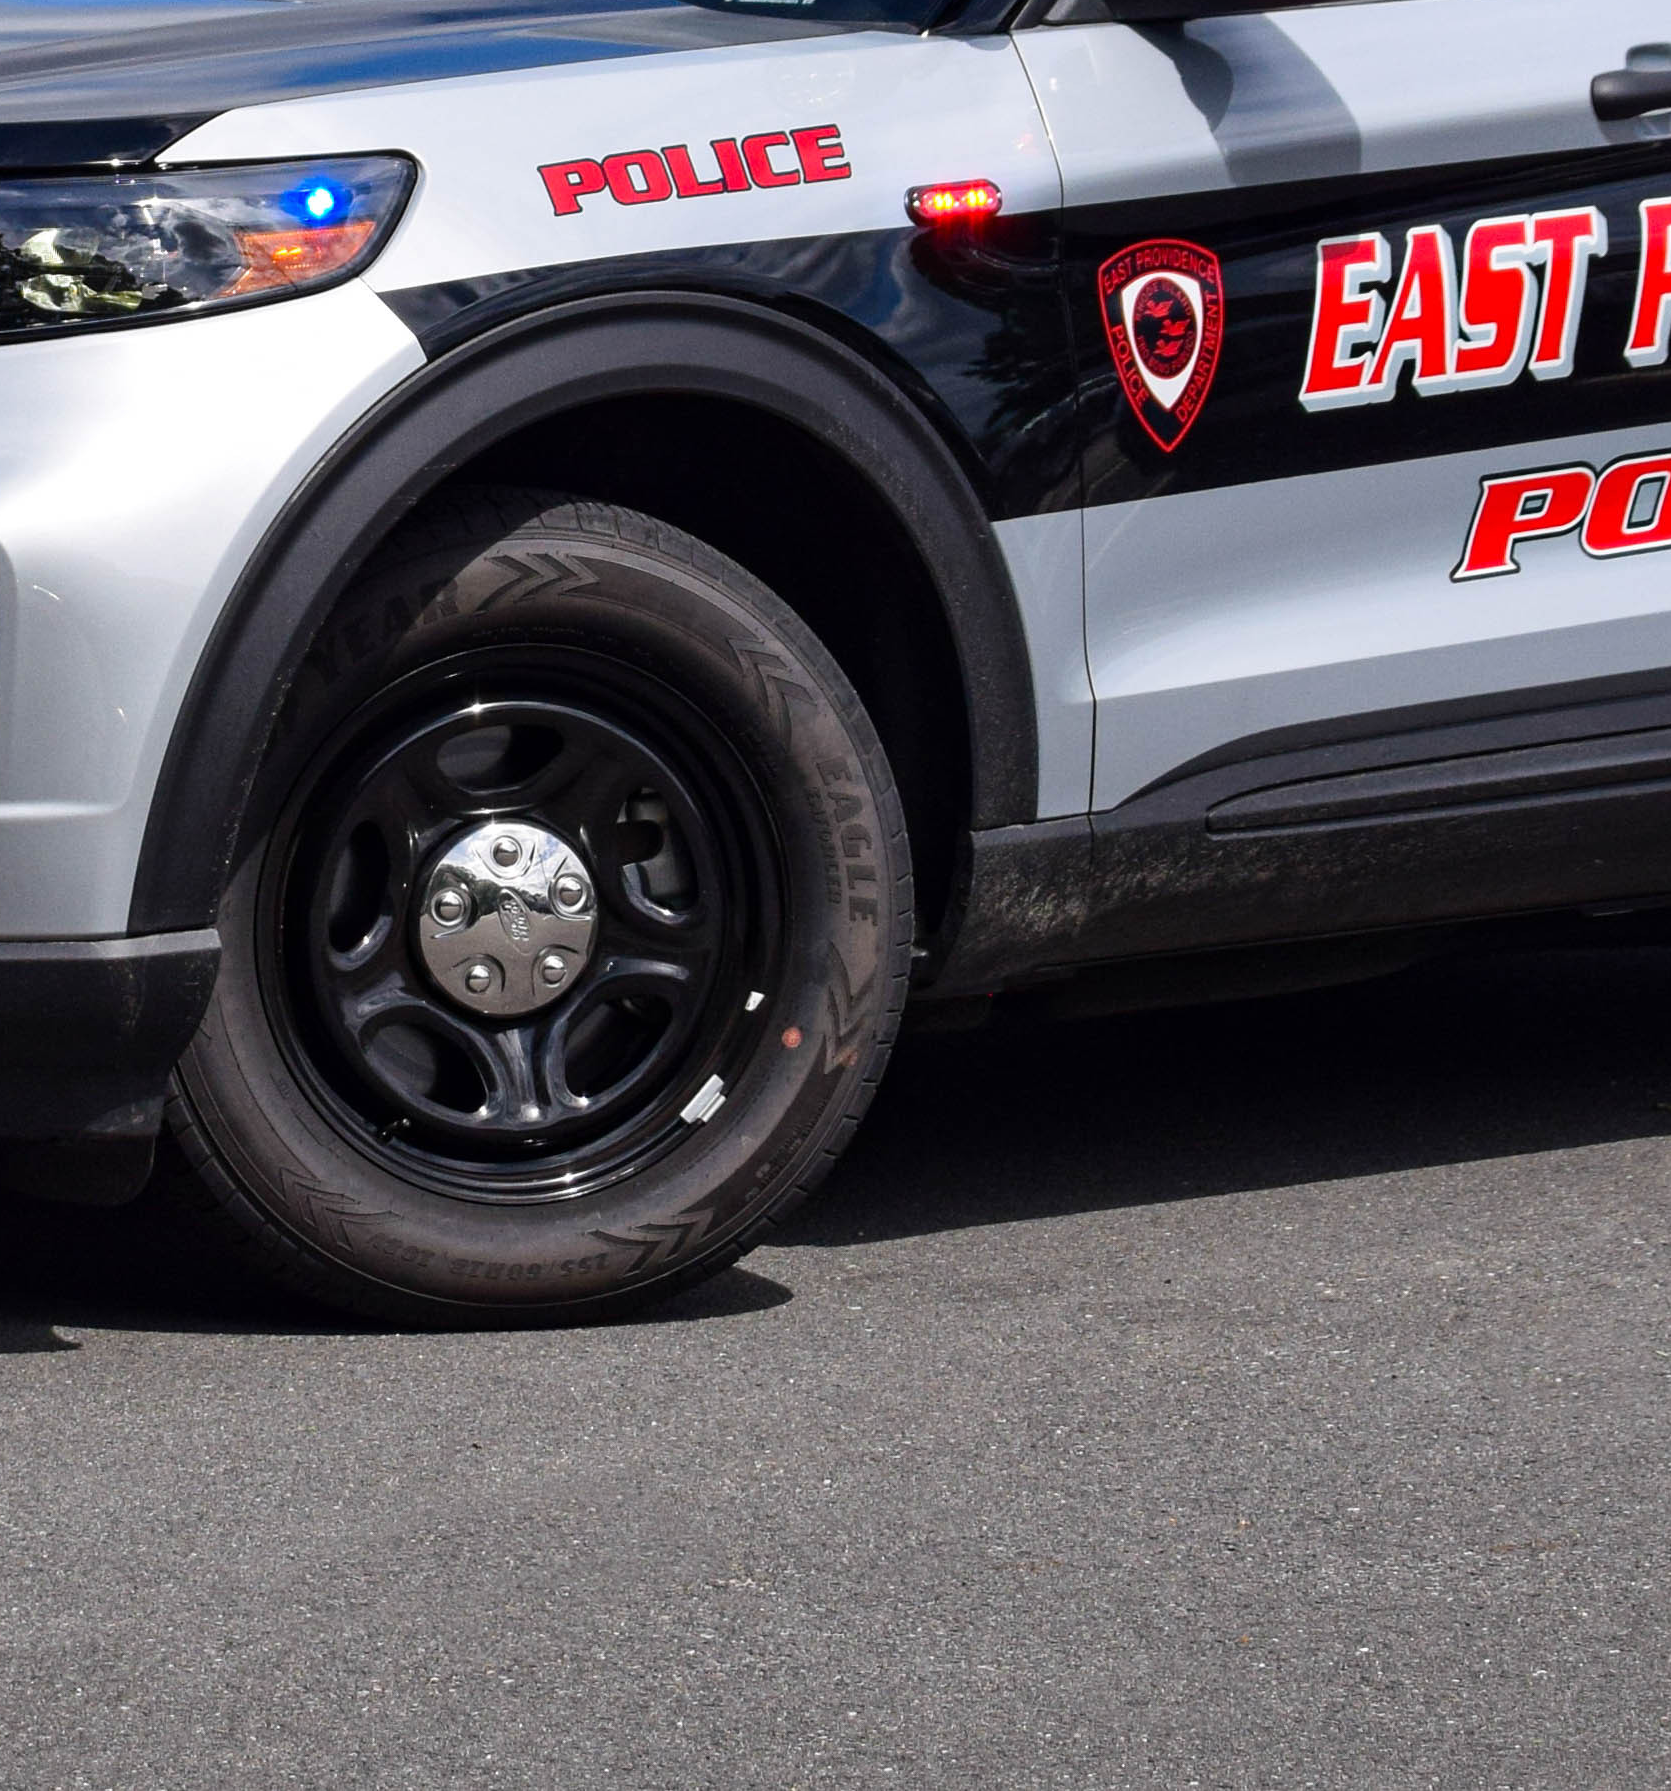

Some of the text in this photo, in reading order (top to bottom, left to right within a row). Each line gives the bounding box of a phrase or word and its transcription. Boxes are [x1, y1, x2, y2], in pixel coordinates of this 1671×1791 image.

[536, 123, 852, 217] POLICE
[1103, 246, 1217, 296] EAST PROVIDENCE
[1299, 205, 1606, 410] EAST
[1110, 324, 1150, 408] POLICE
[1176, 290, 1218, 423] DEPARTMENT
[815, 757, 879, 928] EAGLE
